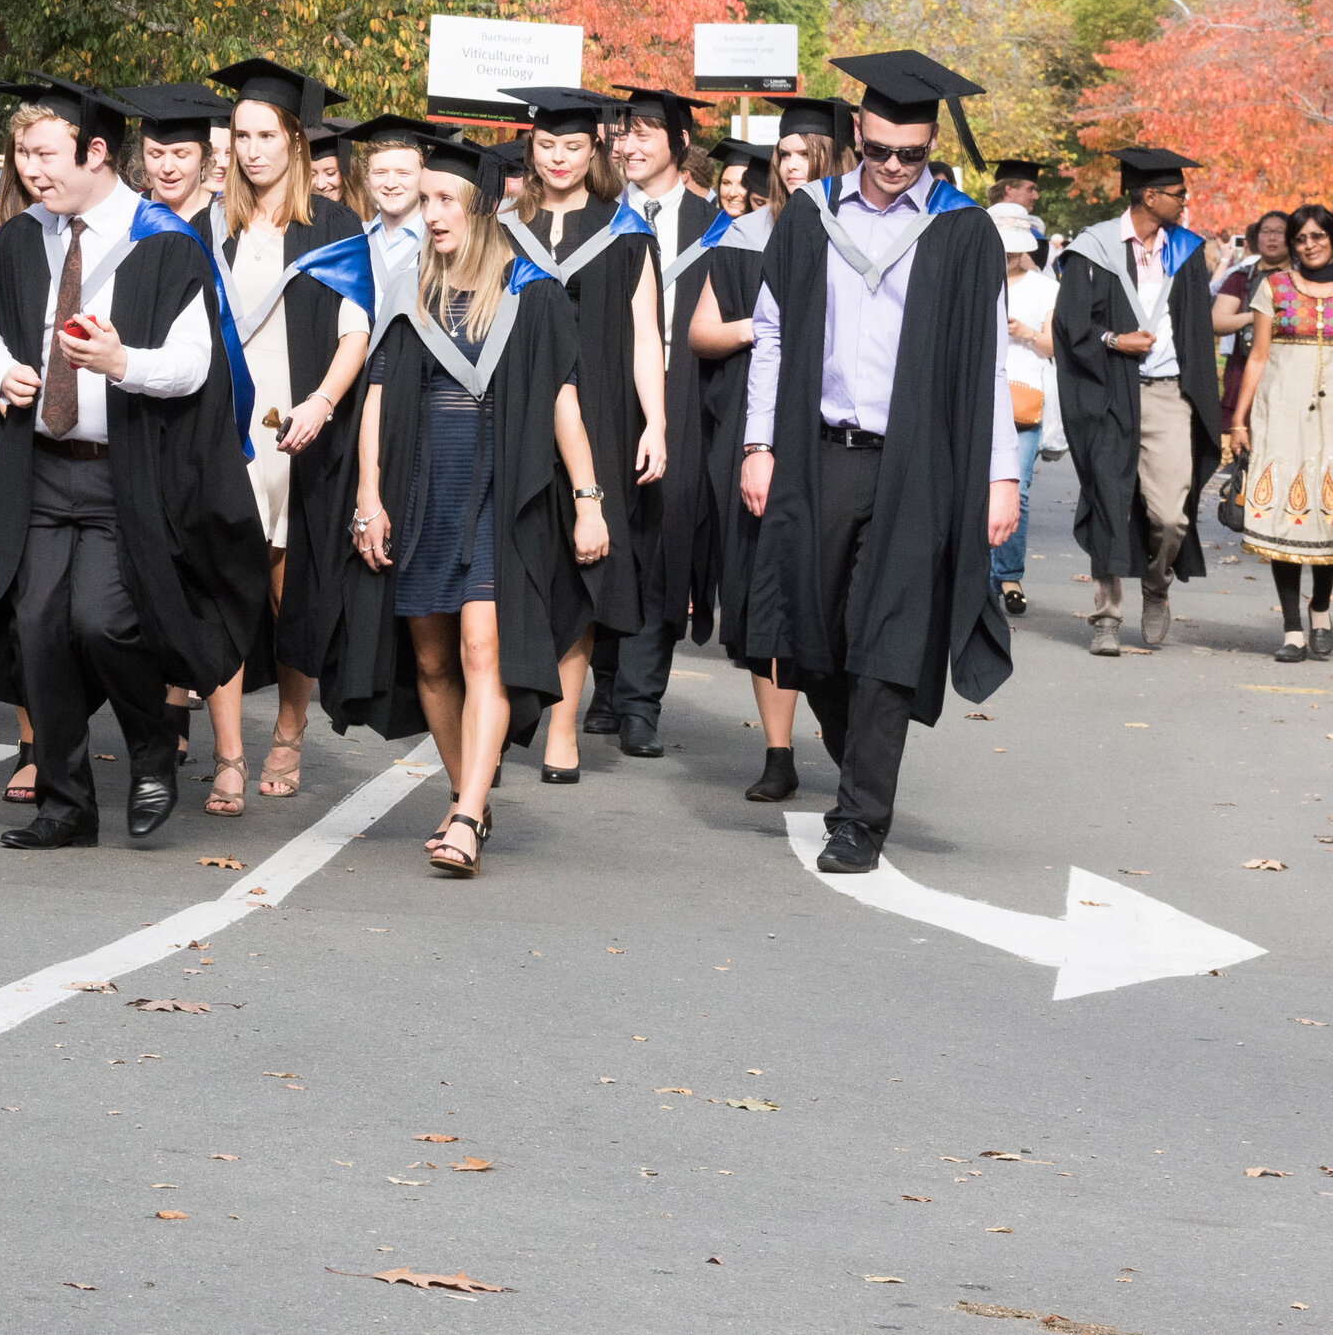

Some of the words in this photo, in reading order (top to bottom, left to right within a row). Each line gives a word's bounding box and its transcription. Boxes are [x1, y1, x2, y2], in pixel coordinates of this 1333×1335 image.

[481, 32, 521, 44] Bachelor
[522, 35, 533, 45] of
[462, 47, 523, 63] Viticulture
[526, 53, 549, 65] and
[476, 63, 534, 81] Oenology
